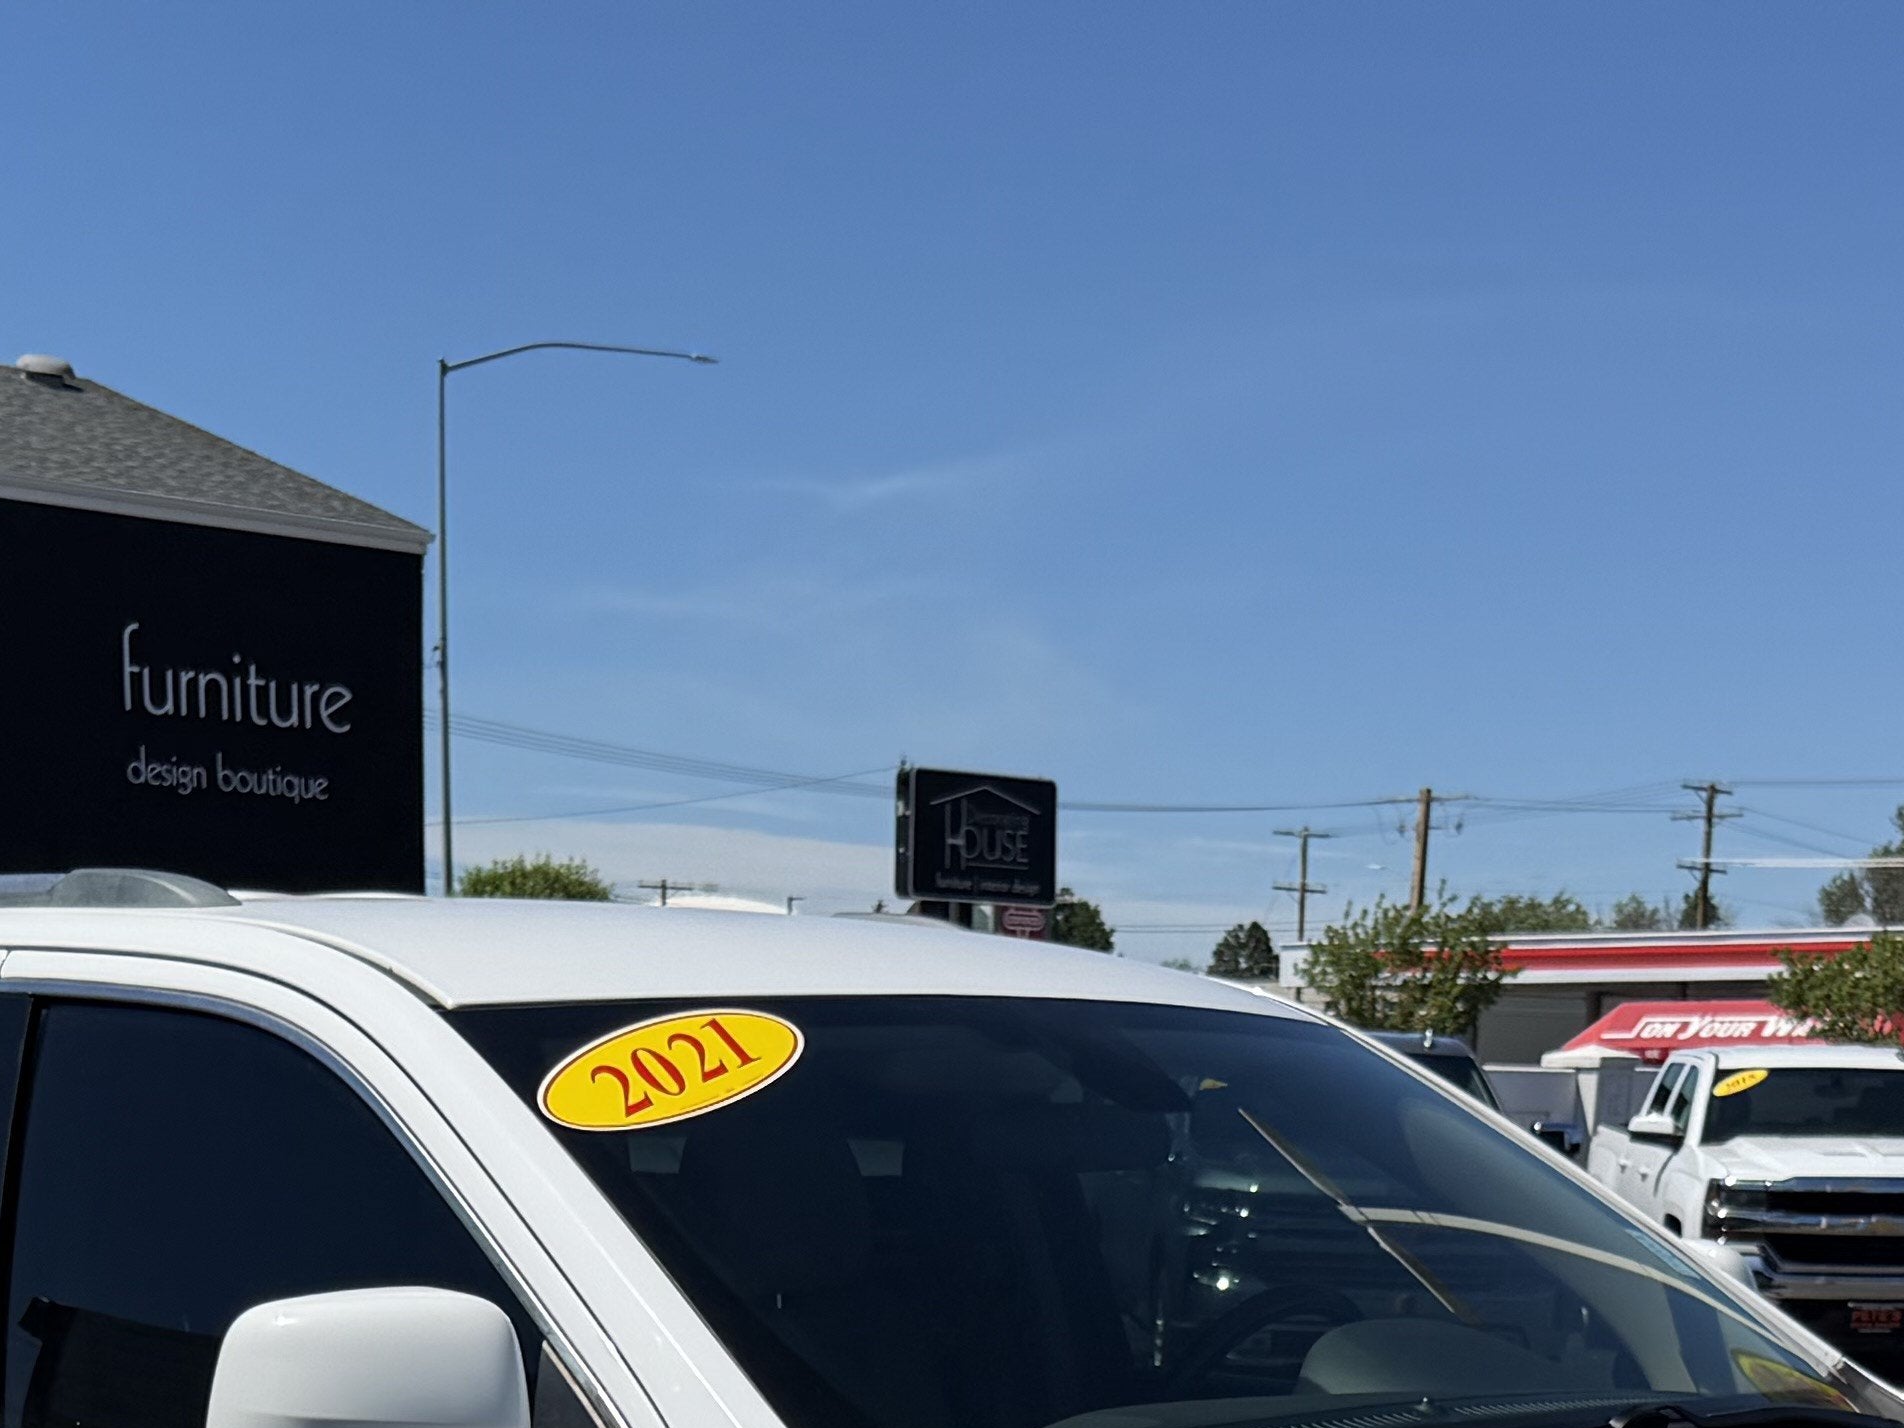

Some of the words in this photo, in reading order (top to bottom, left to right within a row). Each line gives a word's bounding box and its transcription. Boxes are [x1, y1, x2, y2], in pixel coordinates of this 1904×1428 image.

[122, 622, 353, 734] furniture
[126, 745, 208, 795] design
[215, 752, 330, 804] boutique
[944, 798, 1030, 871] HOUSE
[1676, 1015, 1757, 1041] YOUR
[590, 1018, 762, 1118] 2021
